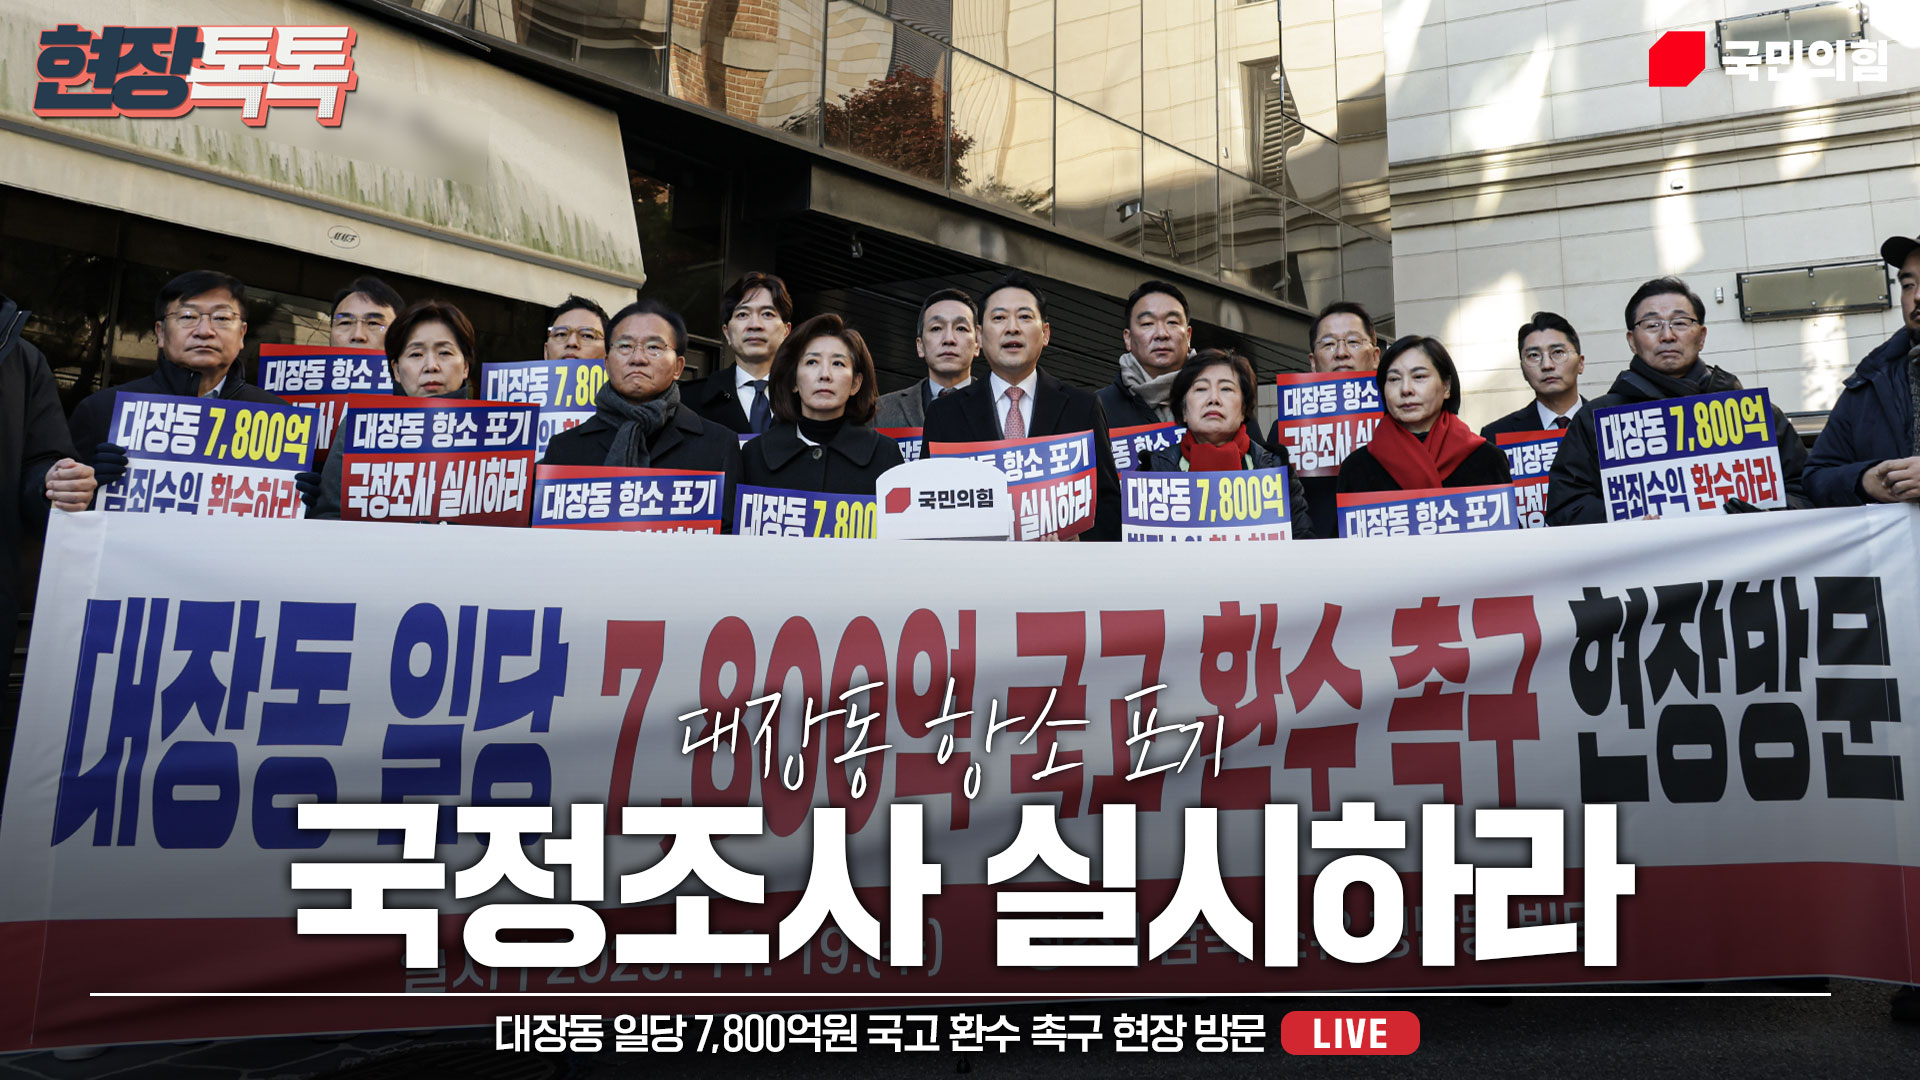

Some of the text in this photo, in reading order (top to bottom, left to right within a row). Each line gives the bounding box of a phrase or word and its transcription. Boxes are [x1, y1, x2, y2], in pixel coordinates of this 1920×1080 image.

[264, 358, 327, 392] 대장동
[331, 357, 373, 391] 항소
[486, 364, 609, 407] 대장동 7,80
[1283, 379, 1380, 417] 대장동 항소
[115, 400, 203, 456] 대장동
[203, 406, 312, 465] 7,800억
[353, 411, 426, 450] 대장동
[431, 410, 479, 449] 항소
[483, 409, 533, 447] 포기
[1284, 420, 1352, 472] 국정조사
[1600, 394, 1769, 461] 대장동 7,800억
[1003, 448, 1044, 483] 항소
[1049, 437, 1090, 475] 포기
[1506, 440, 1559, 482] 대장동
[207, 472, 301, 520] 환수하라
[347, 455, 528, 520] 국정조사 실시하라
[540, 478, 718, 521] 대장동 항소 포기
[917, 487, 995, 510] 국민의힘
[1019, 474, 1094, 542] 실시하라
[1126, 473, 1285, 523] 대장동 7,800억
[1606, 466, 1691, 523] 범죄수익
[1690, 455, 1779, 511] 환수하라
[739, 493, 807, 538] 대장동
[1345, 504, 1410, 539] 대장동
[1415, 499, 1460, 537] 항소
[1465, 491, 1512, 531] 포기
[50, 575, 1905, 856] 대장동 일당 7,800억 국고 환수 촉구 현장방문
